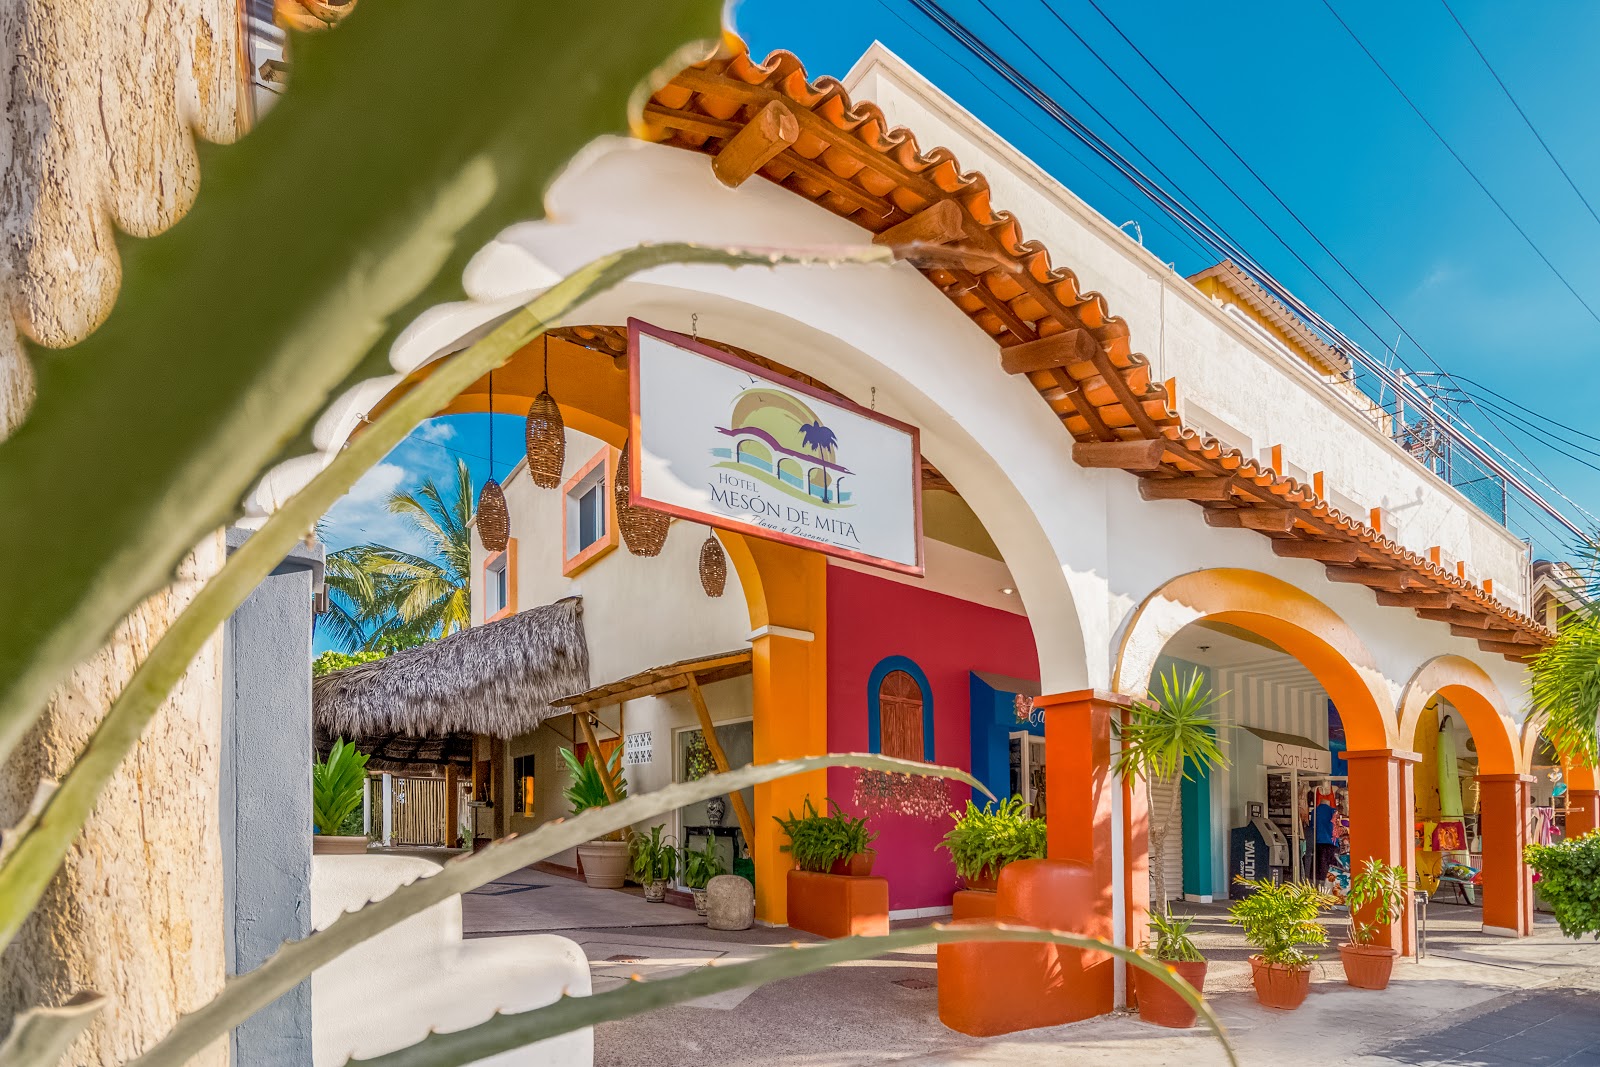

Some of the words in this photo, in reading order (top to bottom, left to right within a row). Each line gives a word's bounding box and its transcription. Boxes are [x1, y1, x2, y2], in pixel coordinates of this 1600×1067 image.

[719, 473, 759, 493] HOTEL
[708, 482, 781, 518] MESÓN
[786, 506, 810, 527] DE
[815, 515, 861, 544] MITA
[1275, 743, 1320, 770] Scarlett
